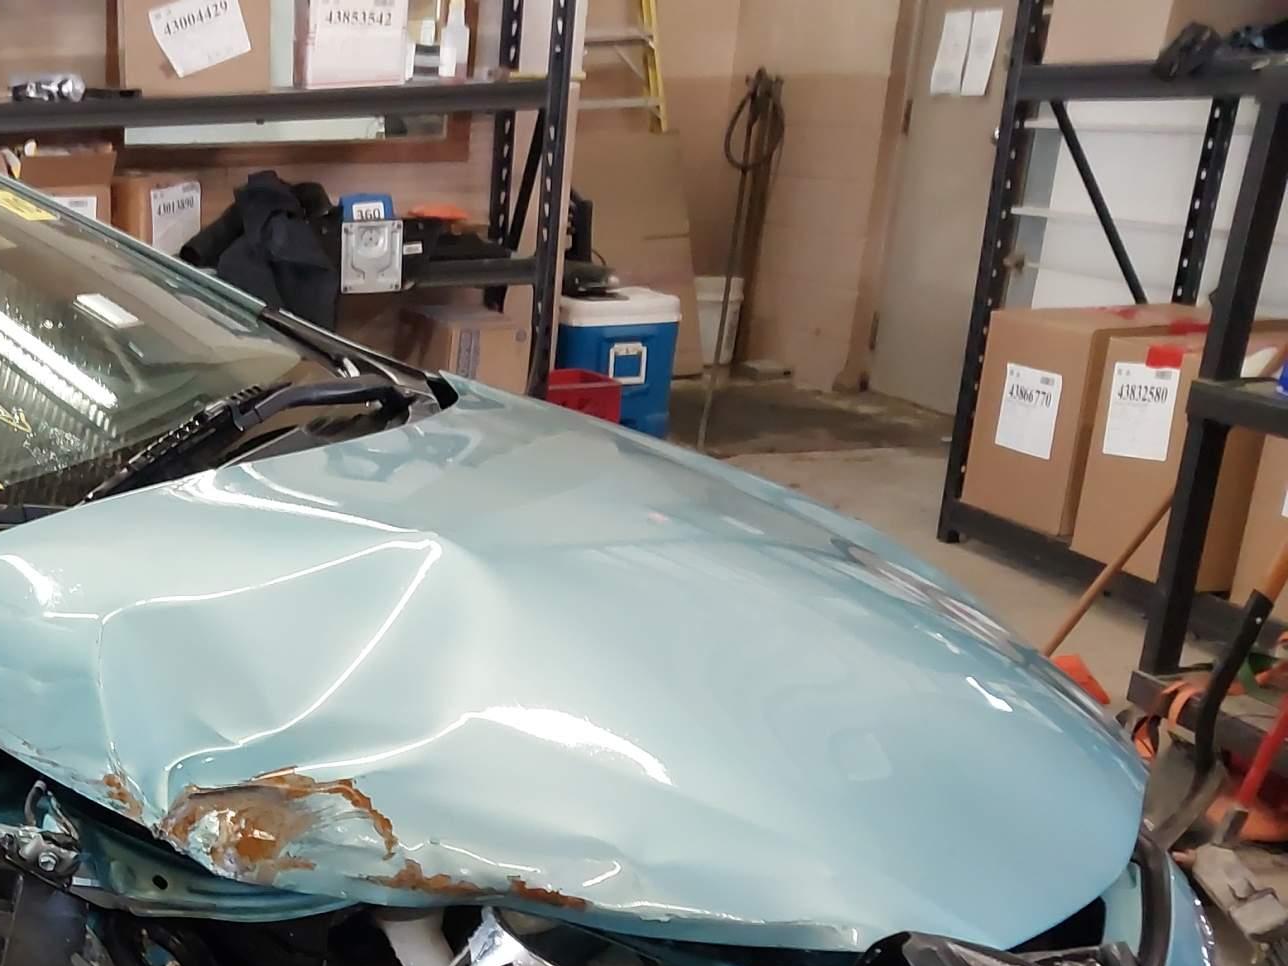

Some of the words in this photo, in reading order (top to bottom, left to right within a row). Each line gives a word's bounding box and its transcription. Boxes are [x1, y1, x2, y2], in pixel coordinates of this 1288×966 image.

[164, 1, 228, 36] 43004429
[1008, 383, 1052, 408] 43866770
[1117, 383, 1168, 403] 43832580
